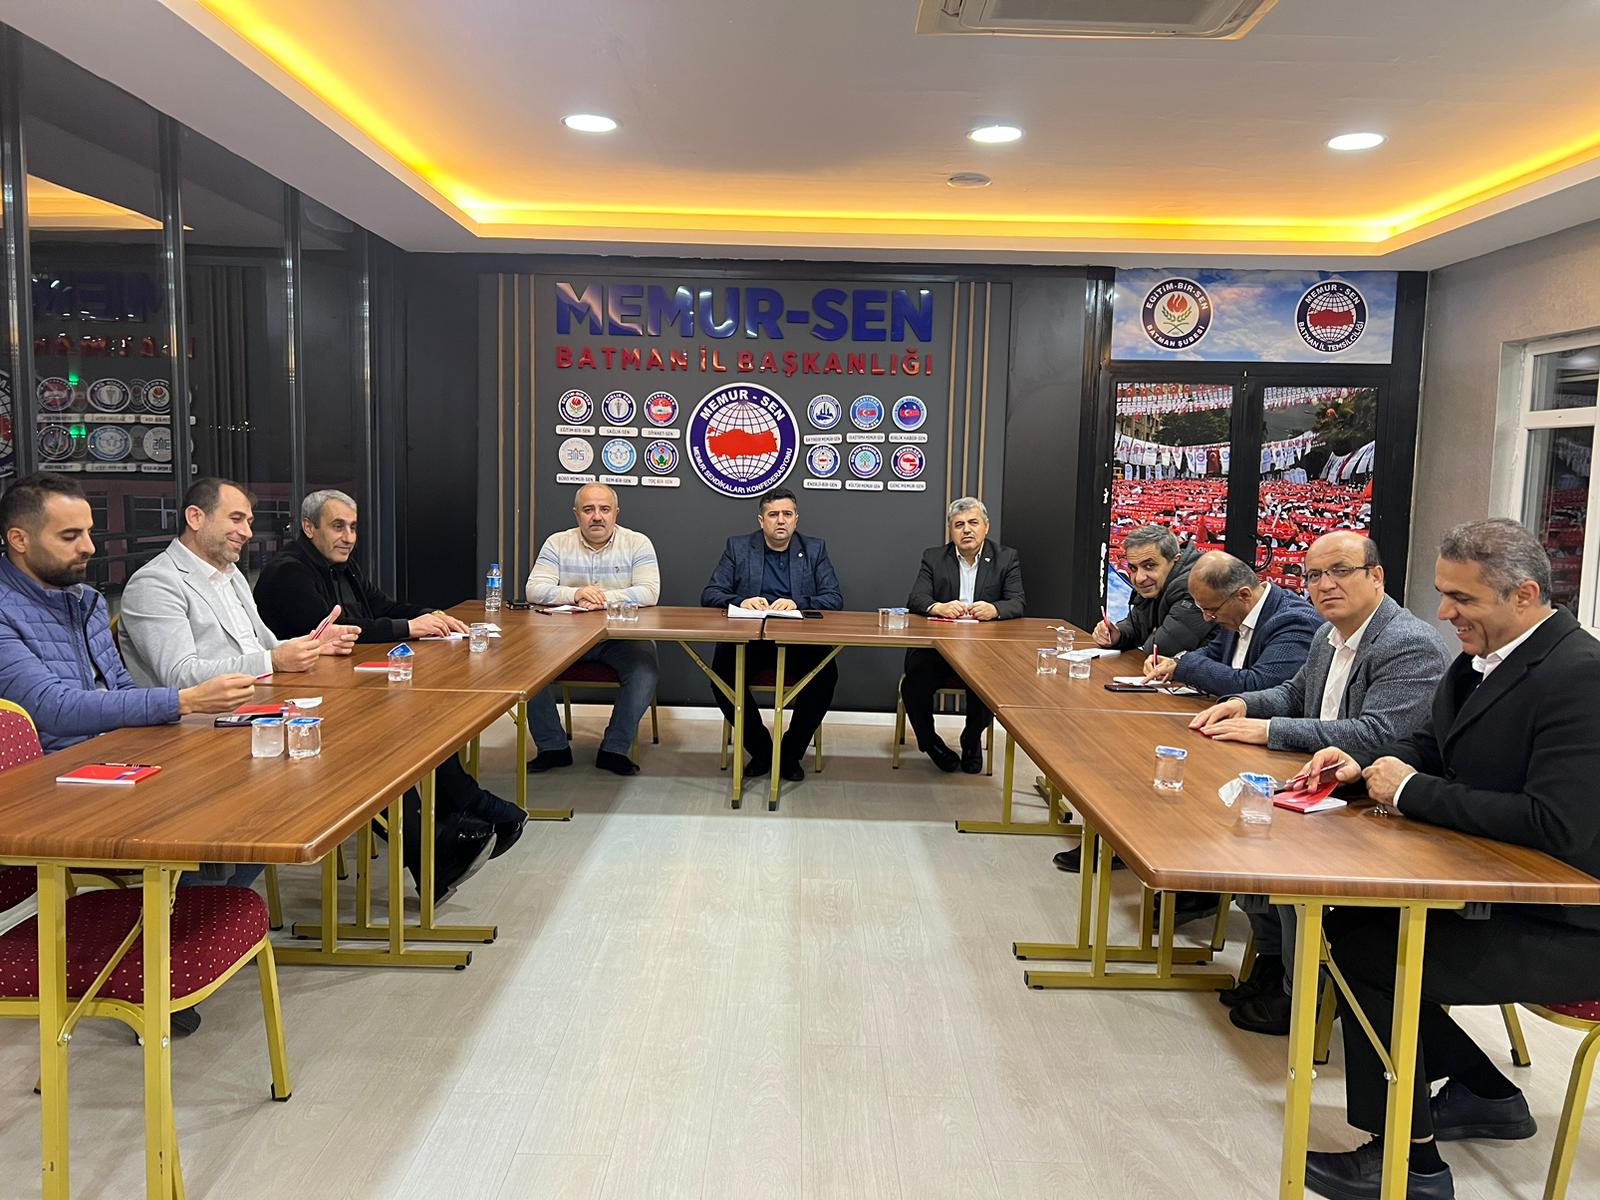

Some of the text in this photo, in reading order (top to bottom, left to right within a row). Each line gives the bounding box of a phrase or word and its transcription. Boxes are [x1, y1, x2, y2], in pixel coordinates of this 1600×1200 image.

[1305, 284, 1337, 304] MEMUR
[1344, 289, 1361, 305] SEN
[555, 282, 933, 342] MEMUR-SEN
[1147, 324, 1176, 347] BATMAN
[1298, 321, 1319, 348] BATMAN
[556, 345, 933, 377] BATMAN İL BAŞKANLIĞI
[699, 389, 749, 421] MEMUR
[760, 396, 786, 422] SEN
[692, 446, 793, 494] MEMUR SENDİKALARI KONFEDERASYONU
